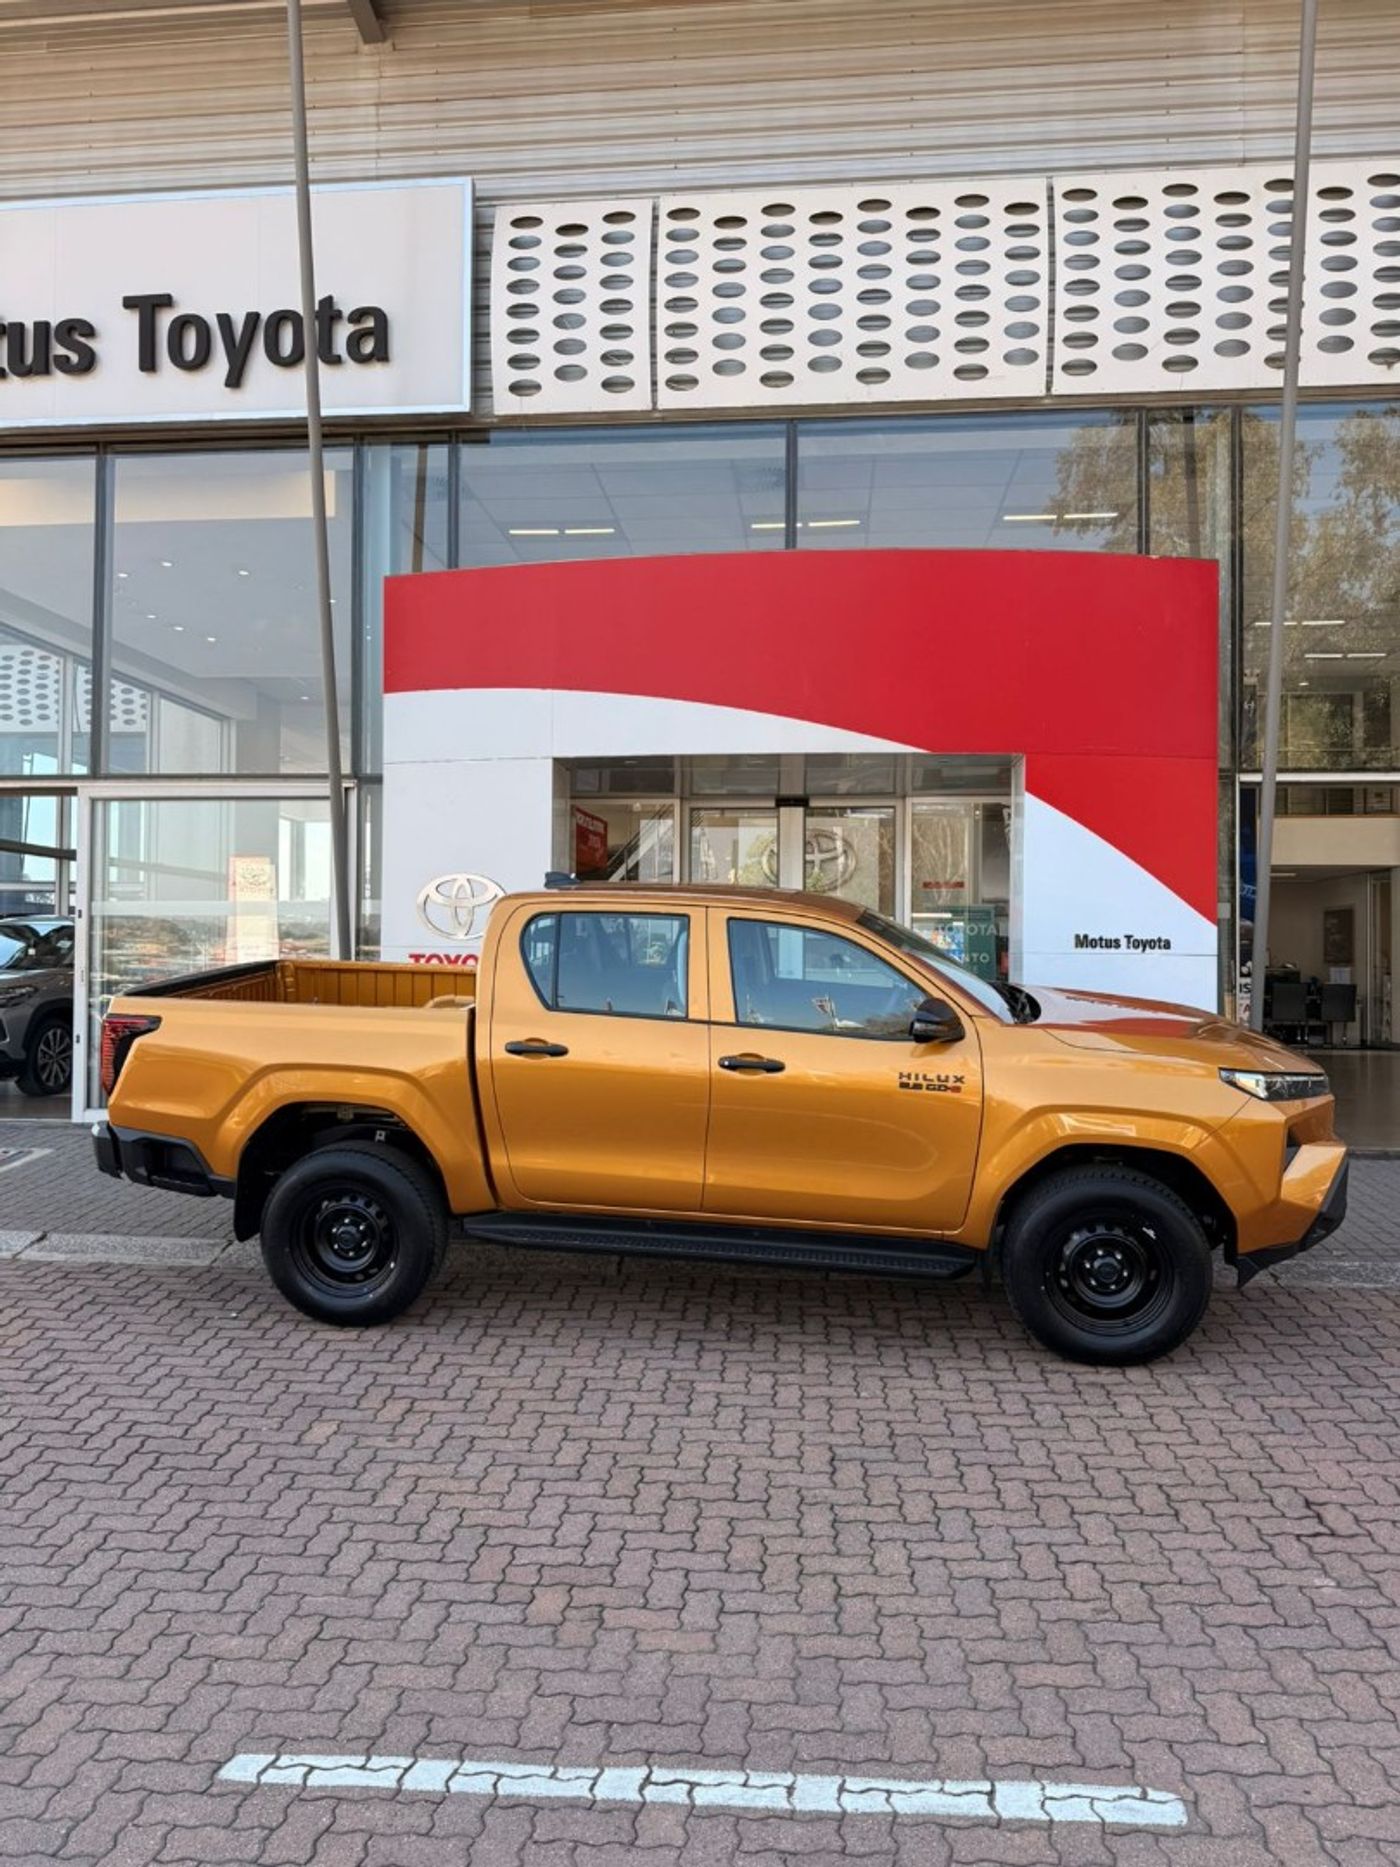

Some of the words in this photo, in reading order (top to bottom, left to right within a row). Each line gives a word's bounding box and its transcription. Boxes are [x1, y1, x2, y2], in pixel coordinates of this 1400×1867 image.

[122, 293, 390, 389] Toyota
[1074, 933, 1122, 949] Motus
[1124, 934, 1172, 953] Toyota
[898, 1071, 966, 1084] HILUX
